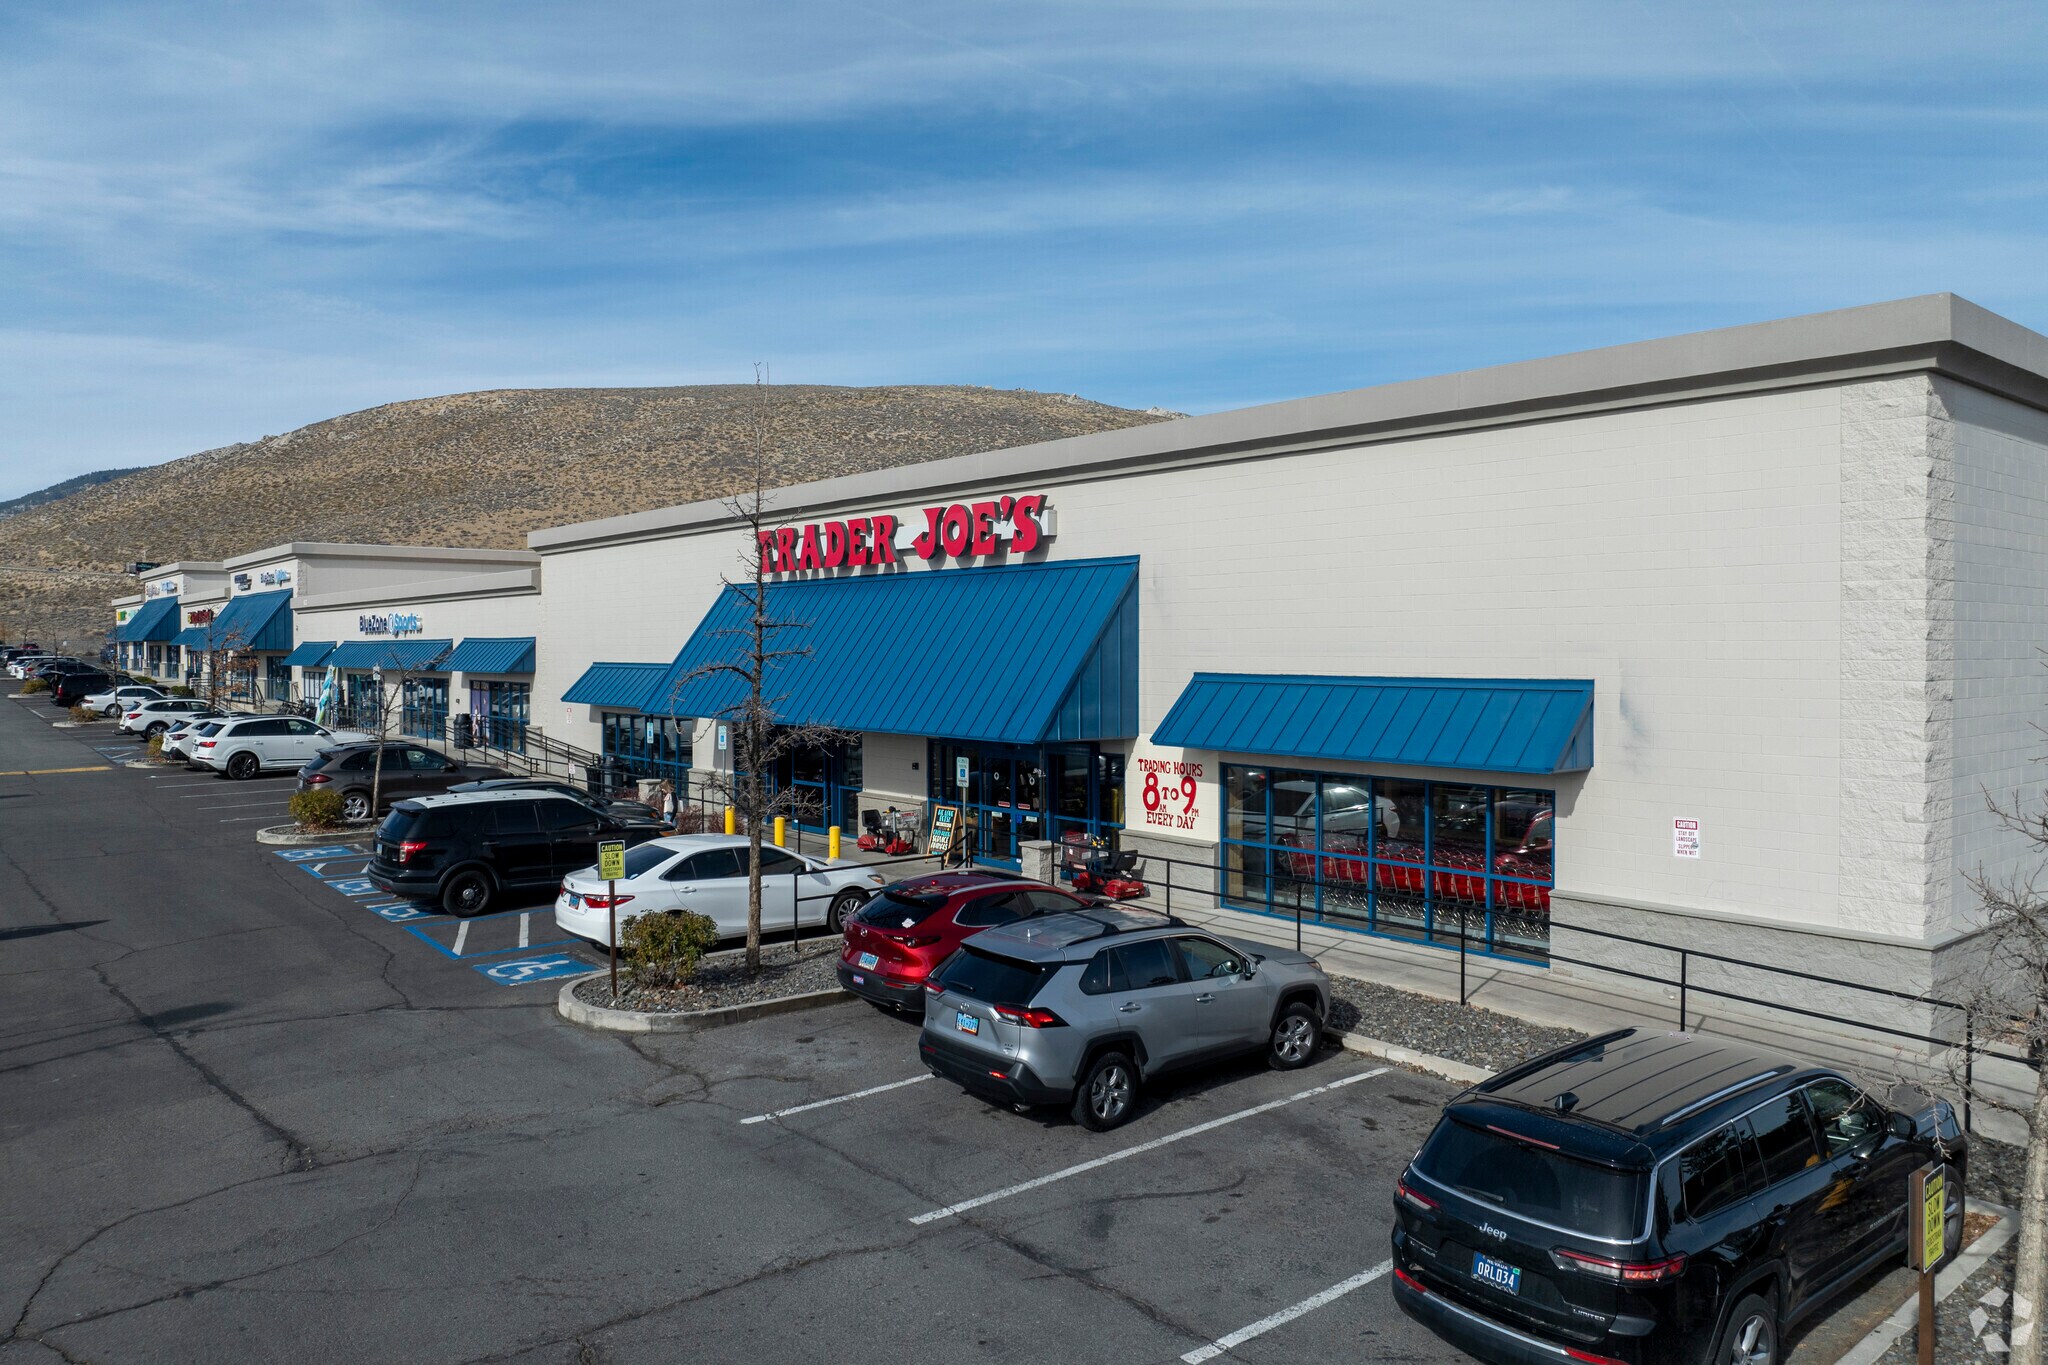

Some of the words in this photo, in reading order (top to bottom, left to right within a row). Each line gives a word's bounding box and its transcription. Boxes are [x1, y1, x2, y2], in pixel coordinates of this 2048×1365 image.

[757, 514, 897, 573] TRADER
[911, 494, 1045, 560] JOE'S
[360, 614, 388, 632] BlueZone
[394, 612, 417, 631] Sports
[1138, 758, 1170, 774] TRADING
[1173, 762, 1202, 777] HOURS
[1142, 772, 1160, 811] 8
[1161, 786, 1179, 800] TO
[1180, 776, 1196, 815] 9
[1158, 804, 1166, 812] AM
[1191, 808, 1199, 817] PM
[1146, 812, 1174, 827] EVERY
[1176, 815, 1196, 830] DAY
[1677, 820, 1696, 828] CAUTION
[1926, 1174, 1942, 1199] CAUTION
[1928, 1195, 1940, 1217] SLOW
[1479, 1222, 1507, 1242] Jeep
[1927, 1211, 1940, 1235] DOWN
[1573, 1308, 1606, 1322] LIMITED
